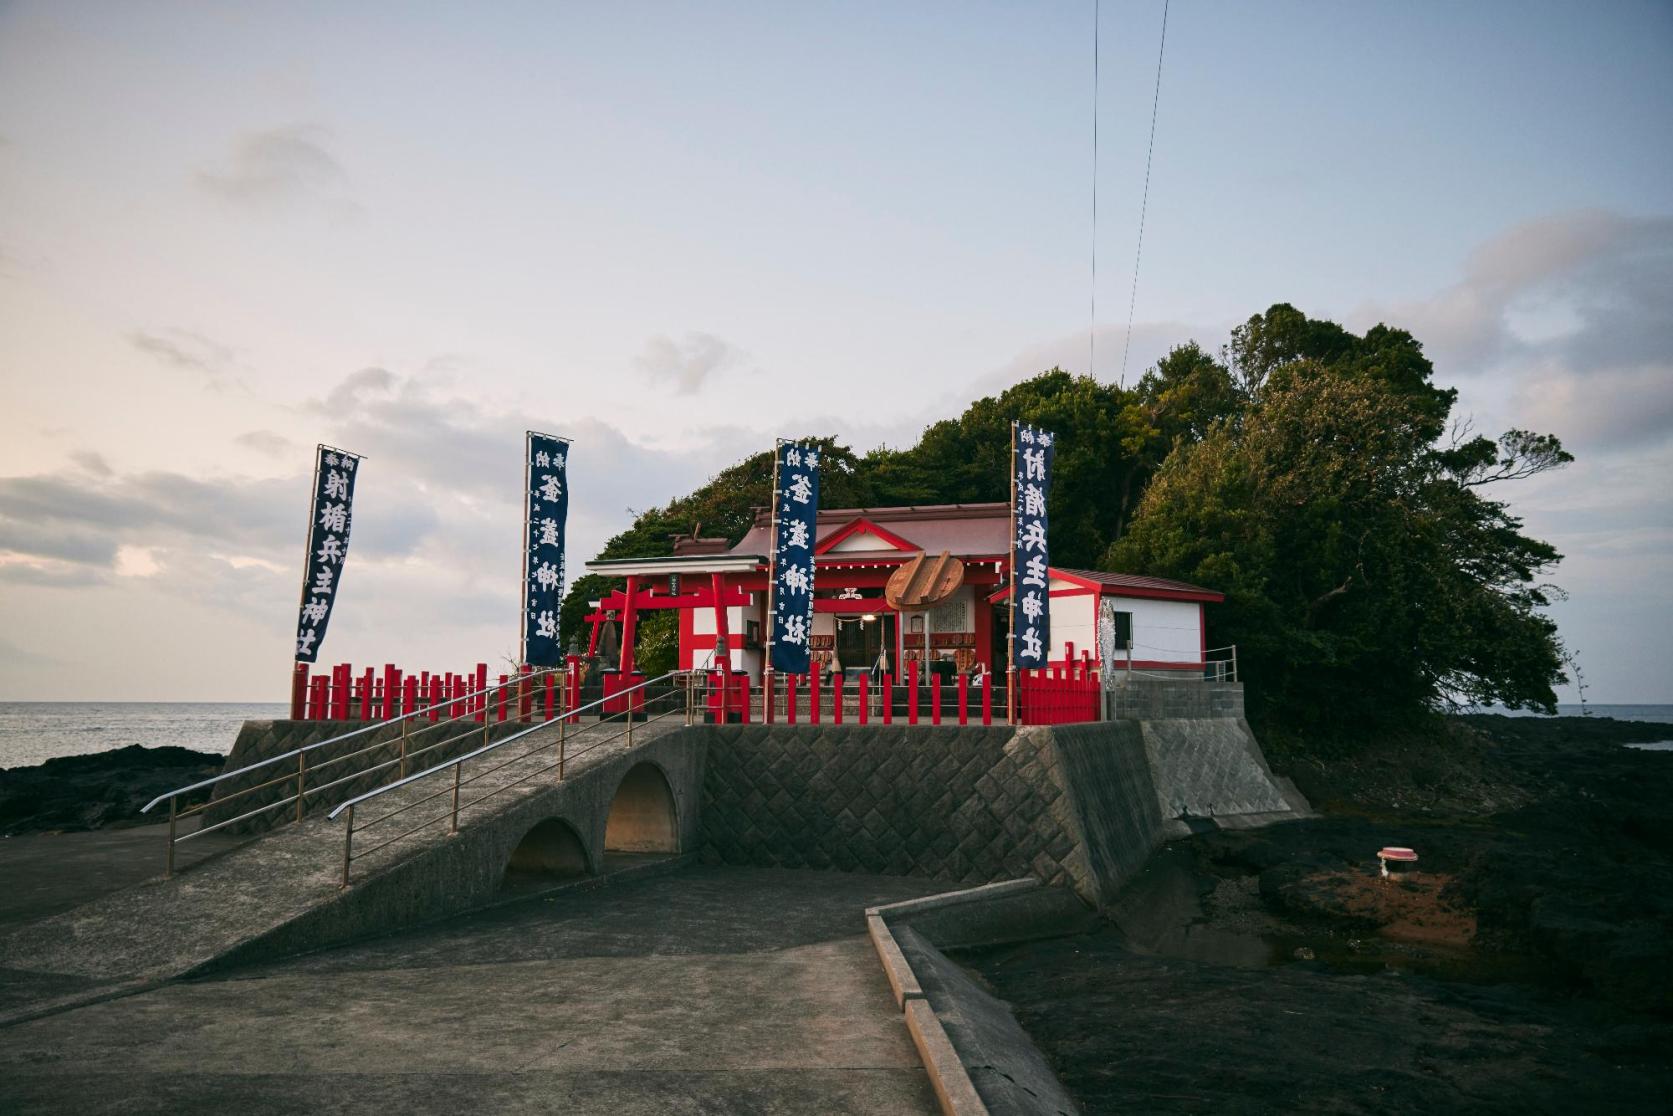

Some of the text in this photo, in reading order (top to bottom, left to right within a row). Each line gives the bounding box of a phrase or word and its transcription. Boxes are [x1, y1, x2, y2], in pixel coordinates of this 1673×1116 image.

[324, 452, 355, 472] 奉納
[296, 469, 349, 656] 射楯兵主神社
